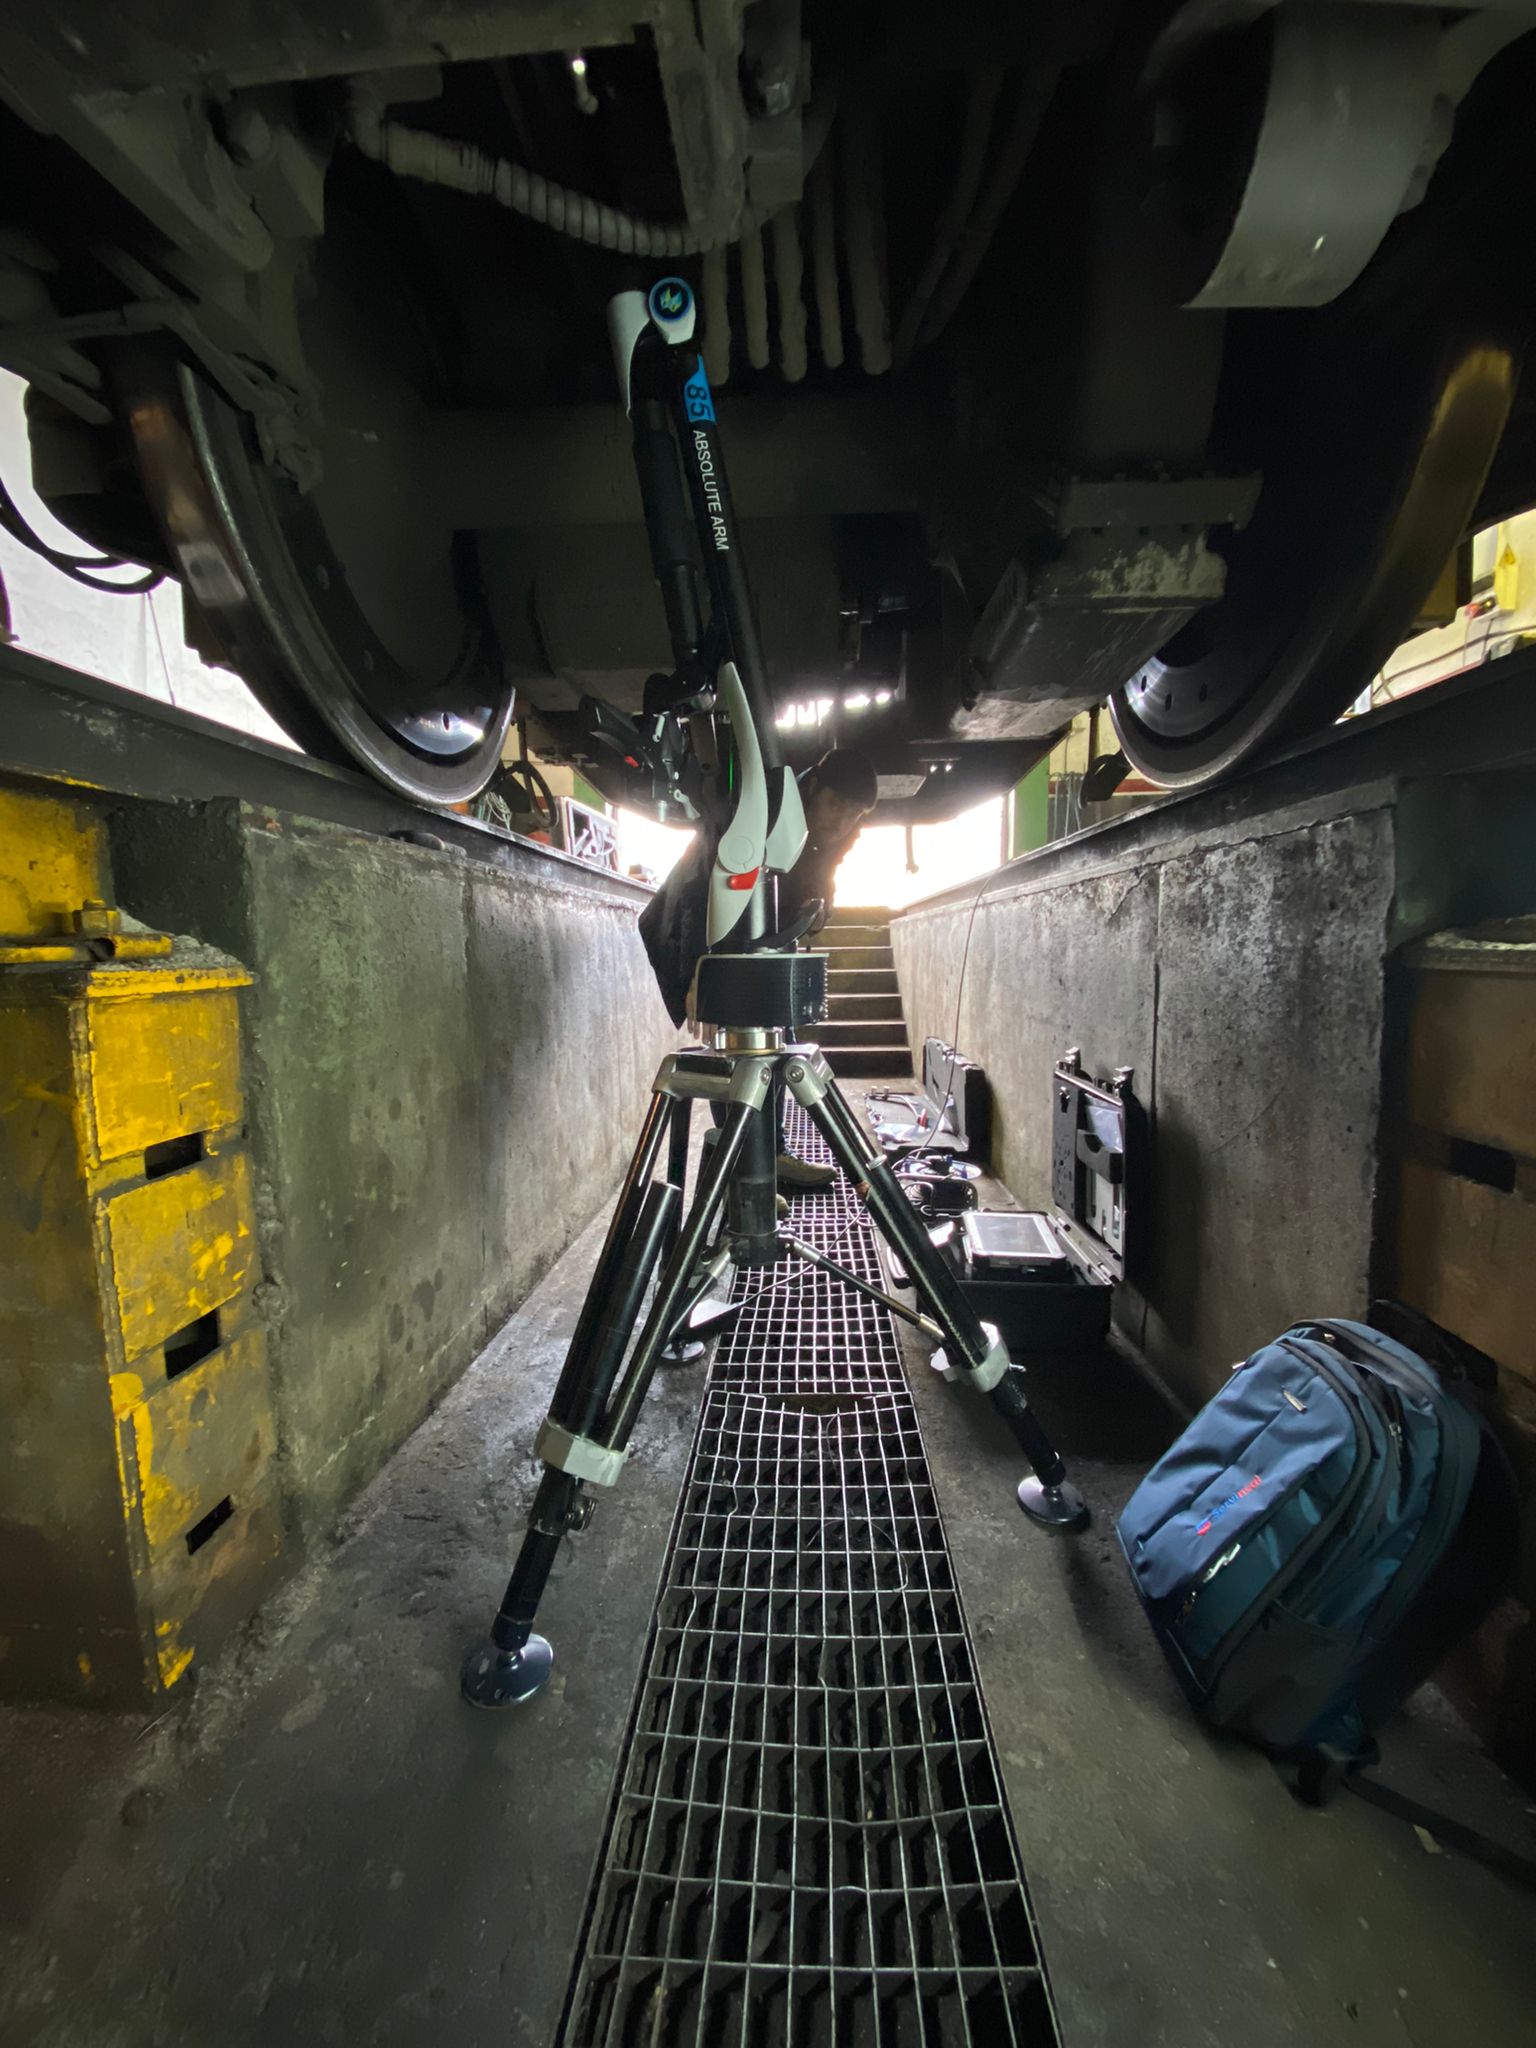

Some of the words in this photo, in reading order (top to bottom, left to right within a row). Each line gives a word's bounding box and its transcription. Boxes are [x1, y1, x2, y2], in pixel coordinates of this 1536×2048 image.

[687, 384, 712, 418] 85
[693, 429, 722, 513] ABSOLUTE
[710, 515, 730, 551] ARM
